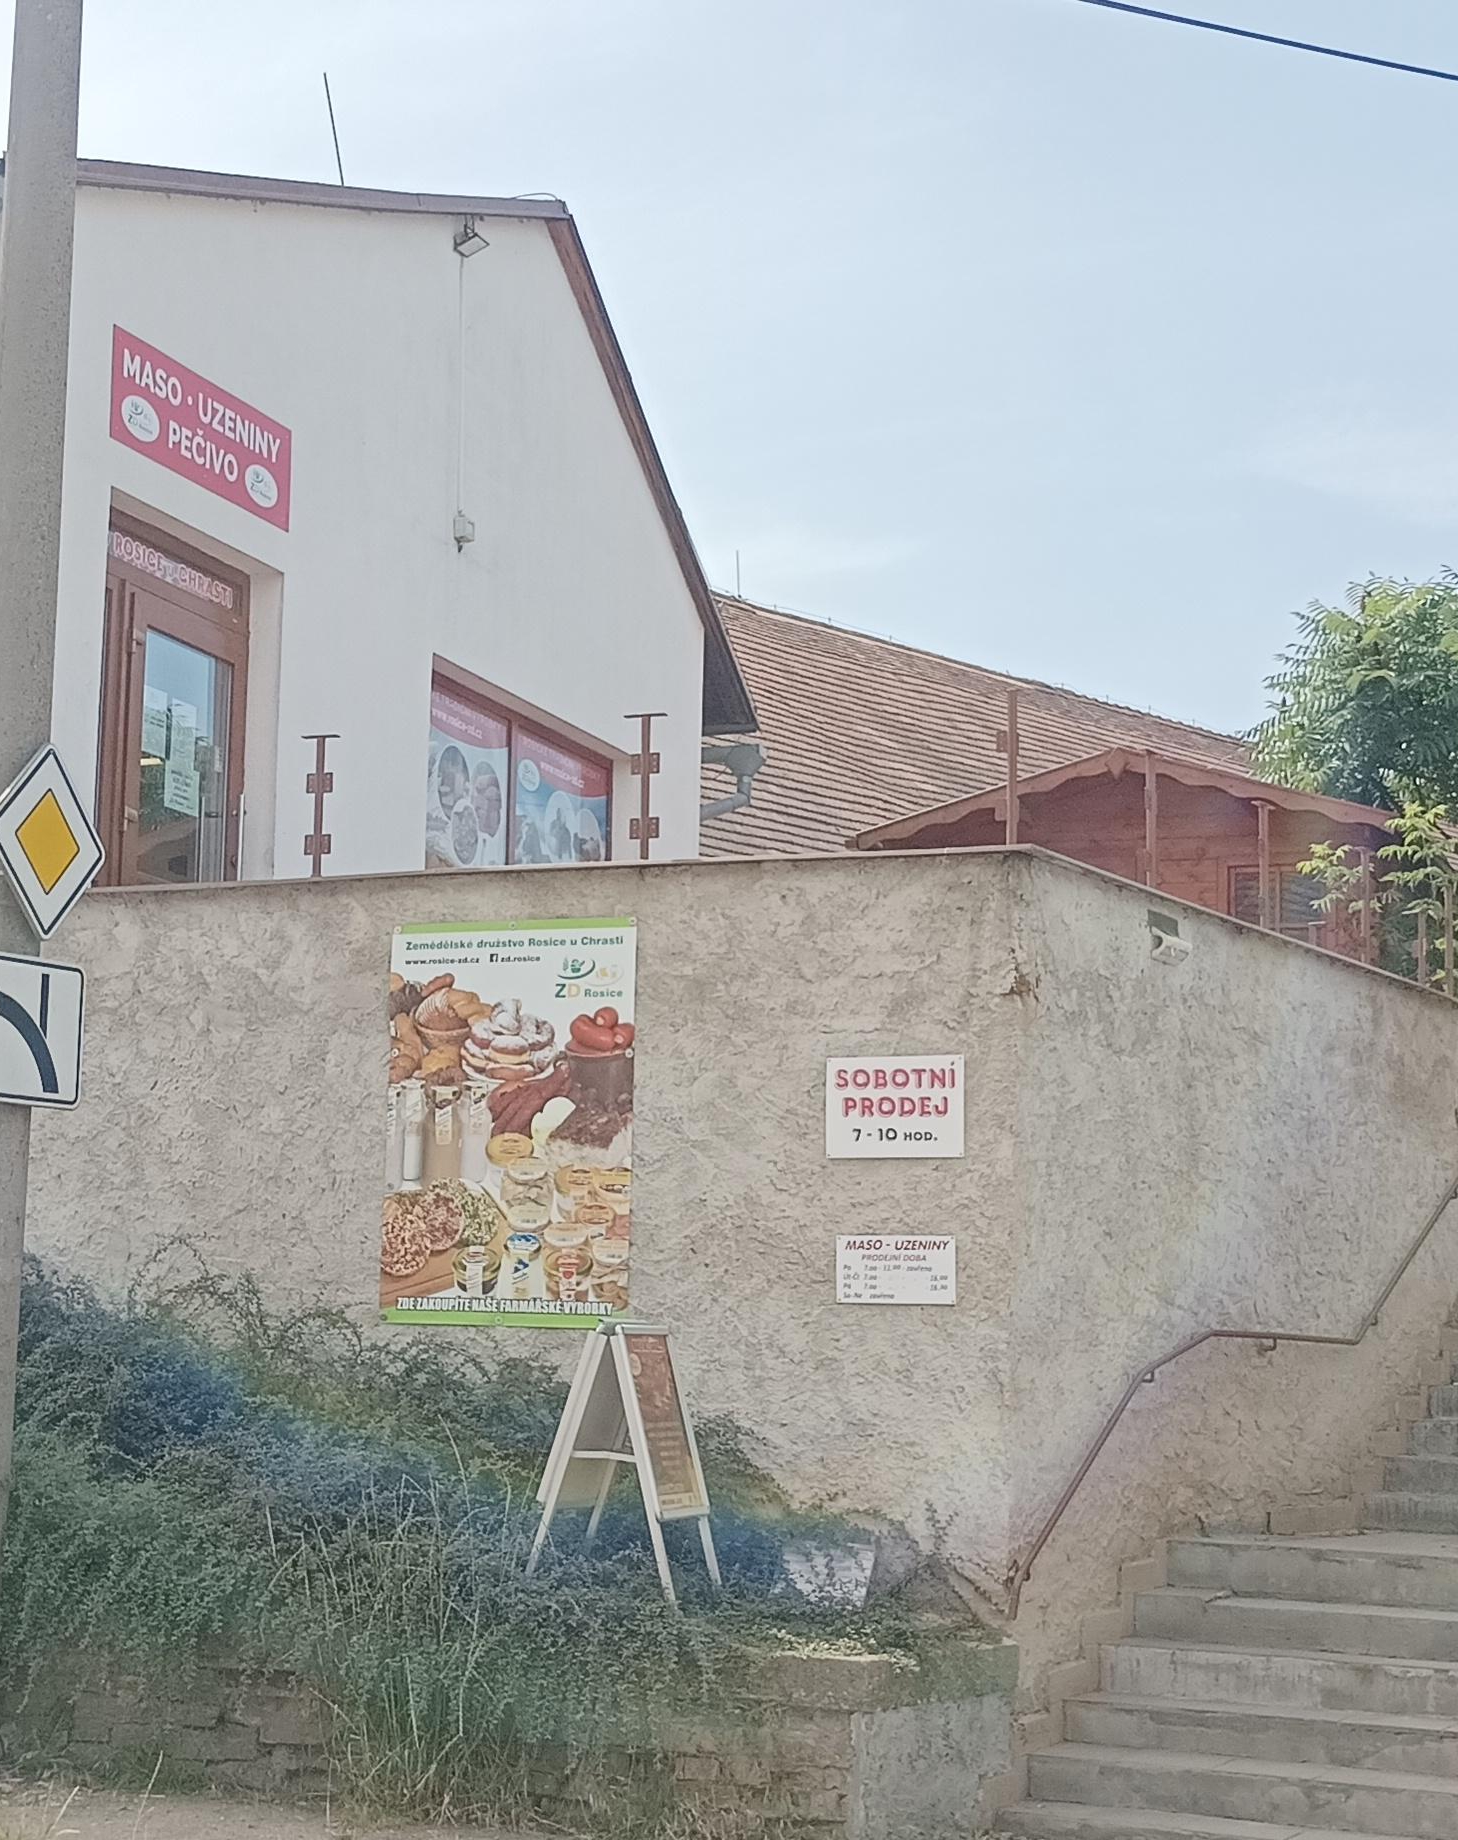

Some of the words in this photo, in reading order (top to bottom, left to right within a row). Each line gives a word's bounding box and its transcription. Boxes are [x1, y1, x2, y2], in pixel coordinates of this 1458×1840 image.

[123, 348, 183, 406] MASO
[198, 392, 280, 463] UZENINY
[168, 420, 239, 482] PEČIVO
[477, 939, 524, 948] družstvo
[528, 938, 566, 947] Rosice
[581, 936, 624, 945] Chrasti
[405, 957, 479, 965] www.rosice-zd.cz
[555, 983, 580, 998] ZD
[584, 988, 623, 997] Rosice
[835, 1061, 956, 1090] SOBOTNÍ
[842, 1096, 949, 1118] PRODEJ
[852, 1128, 861, 1142] 7
[877, 1128, 897, 1142] 10
[903, 1131, 938, 1141] HOD.
[845, 1240, 883, 1250] MASO
[894, 1240, 950, 1250] UZENINY
[397, 1297, 415, 1309] ZDE
[416, 1296, 471, 1311] ZAKOUPÍTE
[472, 1297, 498, 1312] NAŠE
[500, 1298, 562, 1313] FARMÁŘSKÉ
[563, 1300, 613, 1315] VÝROBKY
